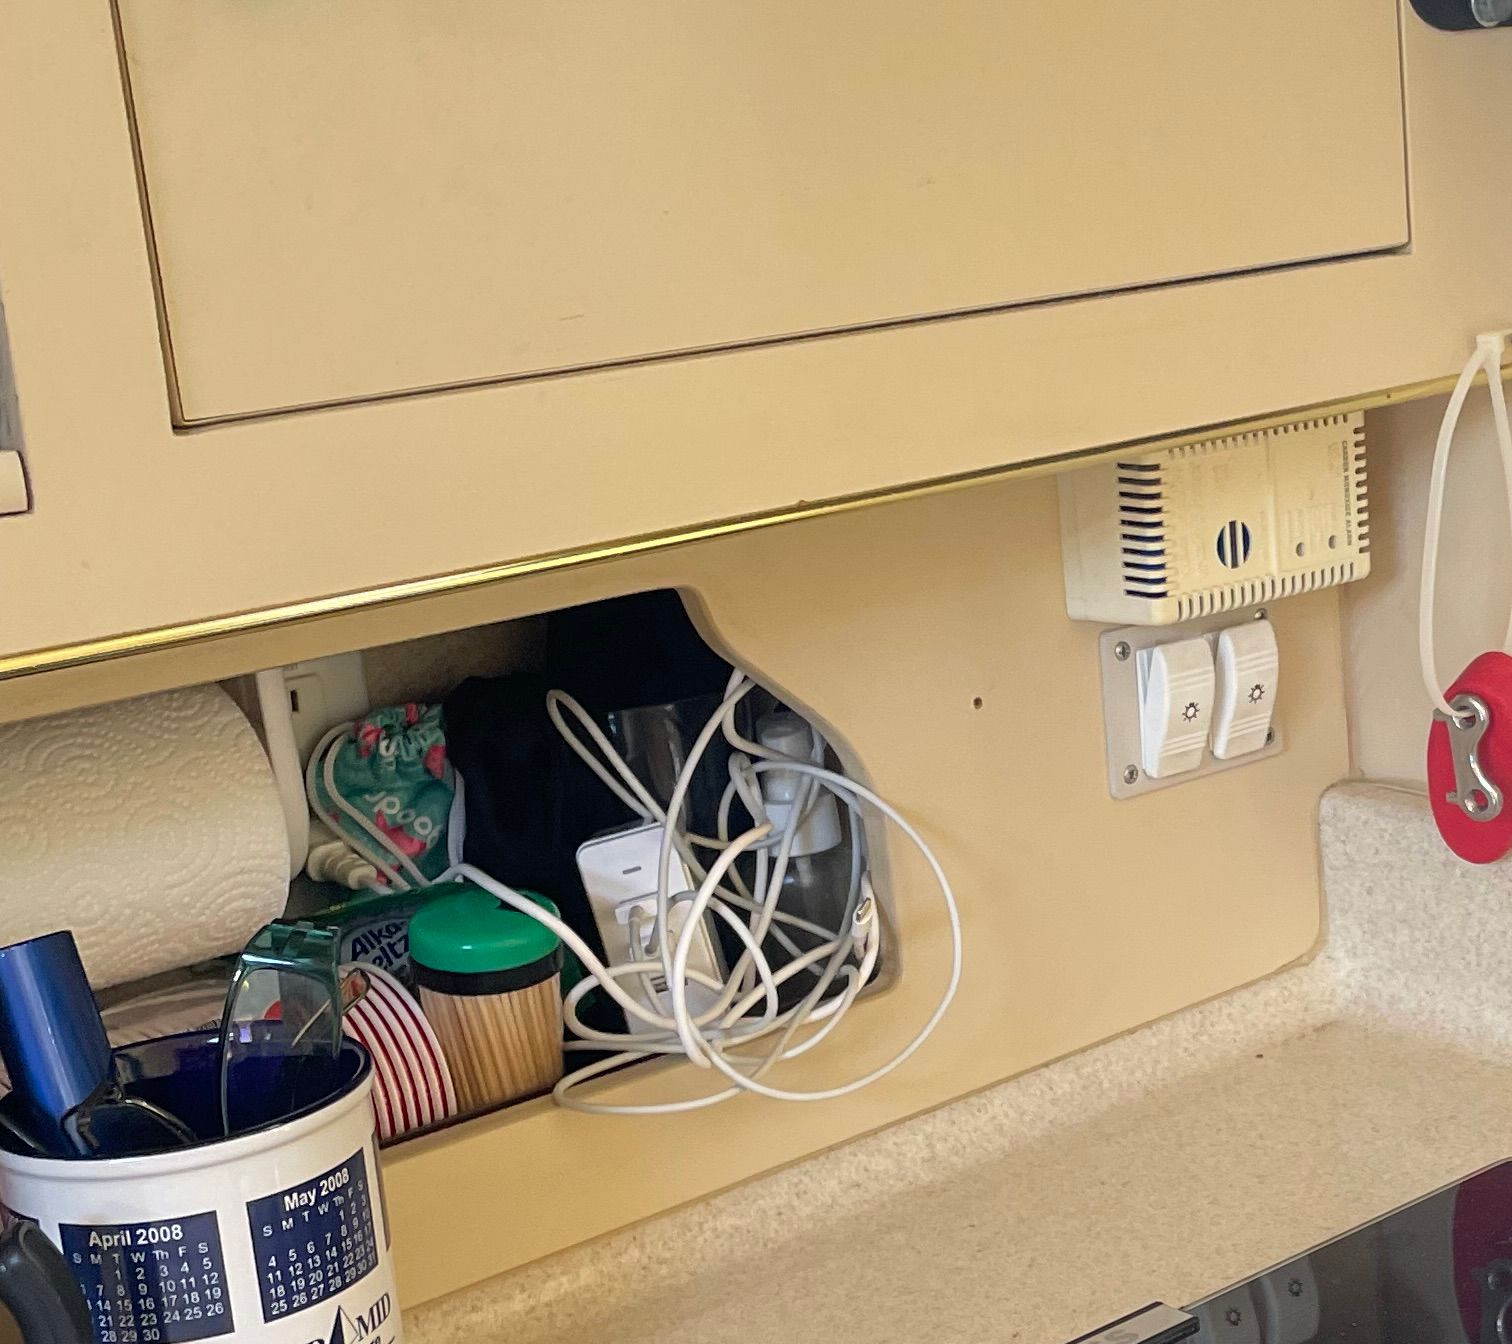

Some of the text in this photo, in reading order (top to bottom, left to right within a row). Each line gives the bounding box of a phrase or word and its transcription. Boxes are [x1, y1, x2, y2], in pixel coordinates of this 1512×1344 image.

[284, 1167, 349, 1211] May 2008
[263, 1225, 272, 1236] S
[282, 1218, 293, 1230] M
[302, 1211, 310, 1222] T
[318, 1202, 329, 1215] W
[333, 1196, 344, 1206] Th
[339, 1203, 356, 1221] 1 2
[89, 1224, 183, 1250] April 2008
[269, 1217, 358, 1267] 4 5 6 7 8 9
[73, 1243, 208, 1264] S M T W Th F S
[267, 1270, 281, 1284] 11
[289, 1263, 302, 1277] 12
[308, 1255, 321, 1269] 13
[326, 1247, 337, 1261] 14
[342, 1238, 352, 1251] 15
[116, 1258, 212, 1280] 1 2 3 4 5
[270, 1286, 285, 1299] 18
[291, 1278, 305, 1292] 19
[309, 1271, 323, 1285] 20
[327, 1262, 339, 1276] 21
[343, 1254, 354, 1268] 22
[96, 1273, 219, 1296] 7 8 9 10 11 12
[271, 1300, 287, 1315] 25
[292, 1292, 307, 1307] 26
[311, 1284, 324, 1300] 27
[329, 1276, 342, 1292] 28
[345, 1267, 356, 1282] 29
[96, 1288, 221, 1311] 14 15 16 17 18 19
[99, 1303, 224, 1327] 21 22 23 24 25 26
[102, 1329, 160, 1342] 28 29 30
